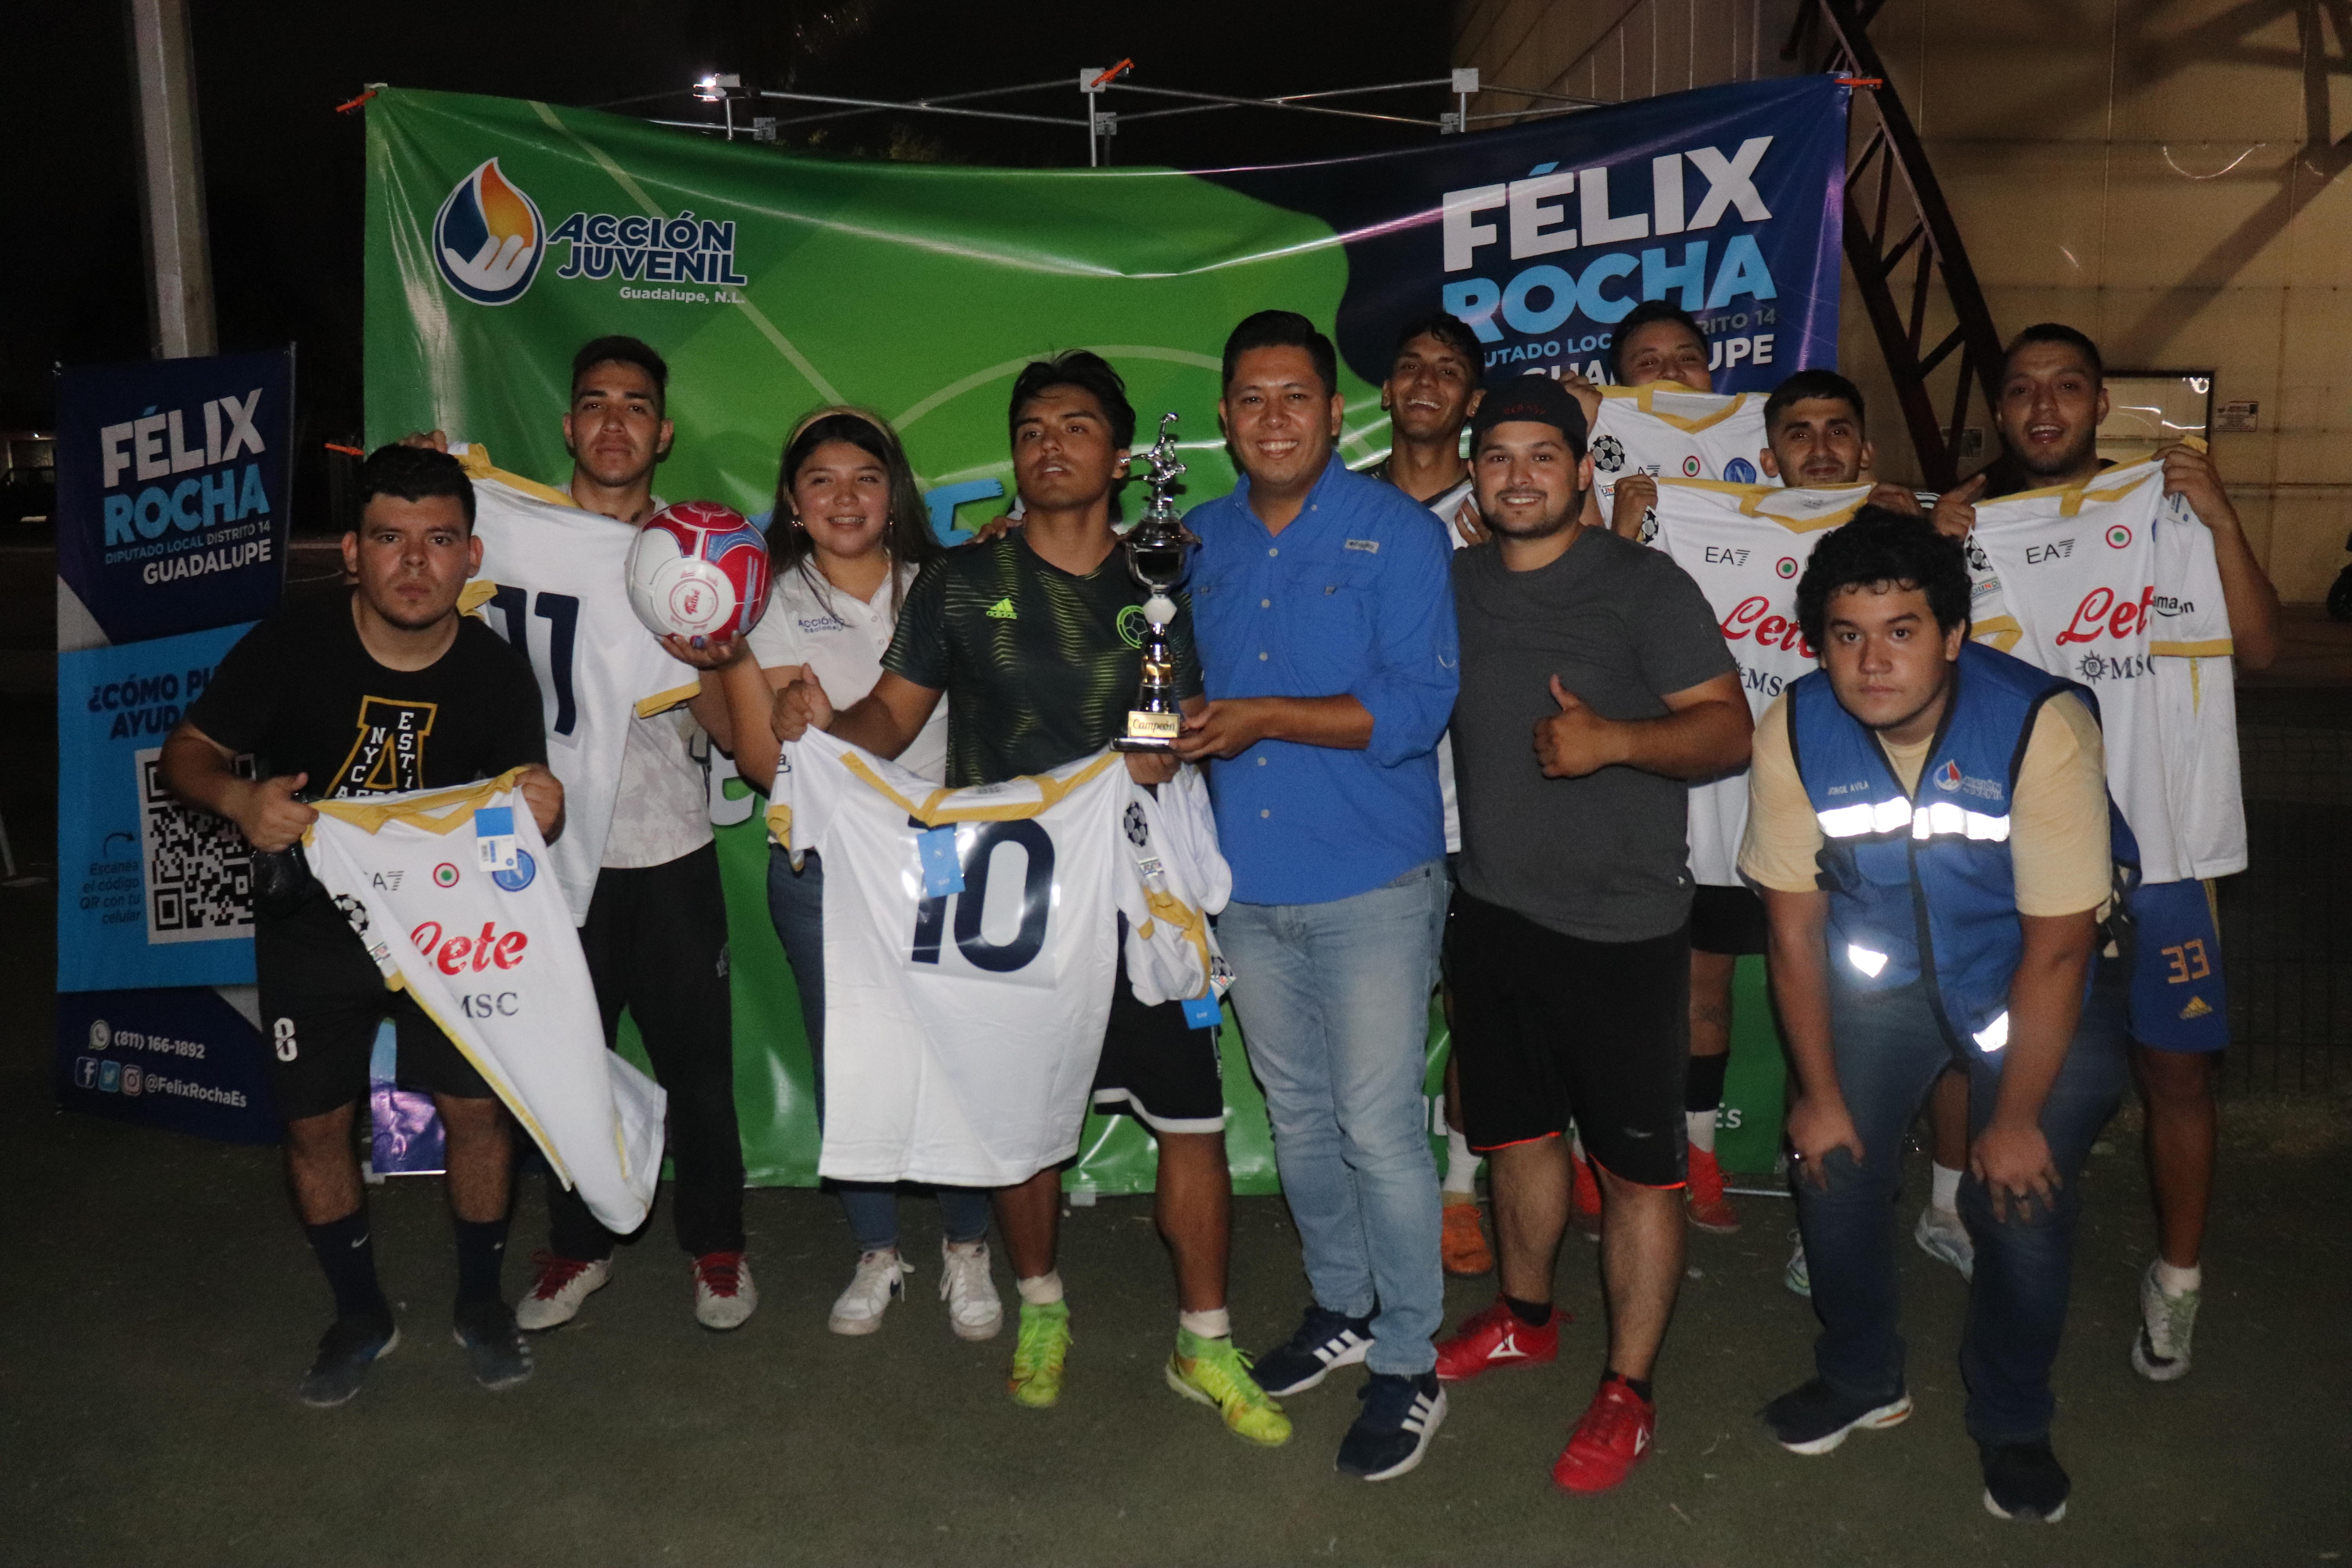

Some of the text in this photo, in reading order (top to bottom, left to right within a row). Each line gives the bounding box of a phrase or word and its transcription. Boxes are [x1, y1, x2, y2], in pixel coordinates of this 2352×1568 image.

[1443, 135, 1773, 272] FÉLIX
[546, 210, 735, 252] ACCIÓN
[557, 244, 747, 286] JUVENIL
[620, 286, 745, 304] Guadalupe, N.L.
[1443, 234, 1777, 344] ROCHA
[1485, 308, 1776, 368] UTADO LOC RITO 14
[101, 388, 265, 488] FÉLIX
[103, 463, 270, 547] ROCHA
[105, 520, 270, 565] DIPUTADO LOCAL DISTRITO 14
[143, 539, 271, 584] GUADALUPE
[2056, 586, 2155, 646] Let
[87, 673, 179, 712] ¿CÓMO
[1745, 668, 1786, 697] MS
[109, 704, 180, 740] AYUD
[80, 894, 141, 910] QR con tu
[83, 877, 139, 893] el código
[908, 818, 1055, 972] 10
[103, 909, 141, 924] celular
[2161, 939, 2210, 983] 33
[114, 1031, 205, 1059] (811) 166-1892
[274, 1018, 298, 1062] 8
[145, 1074, 247, 1108] @FelixRochaEs
